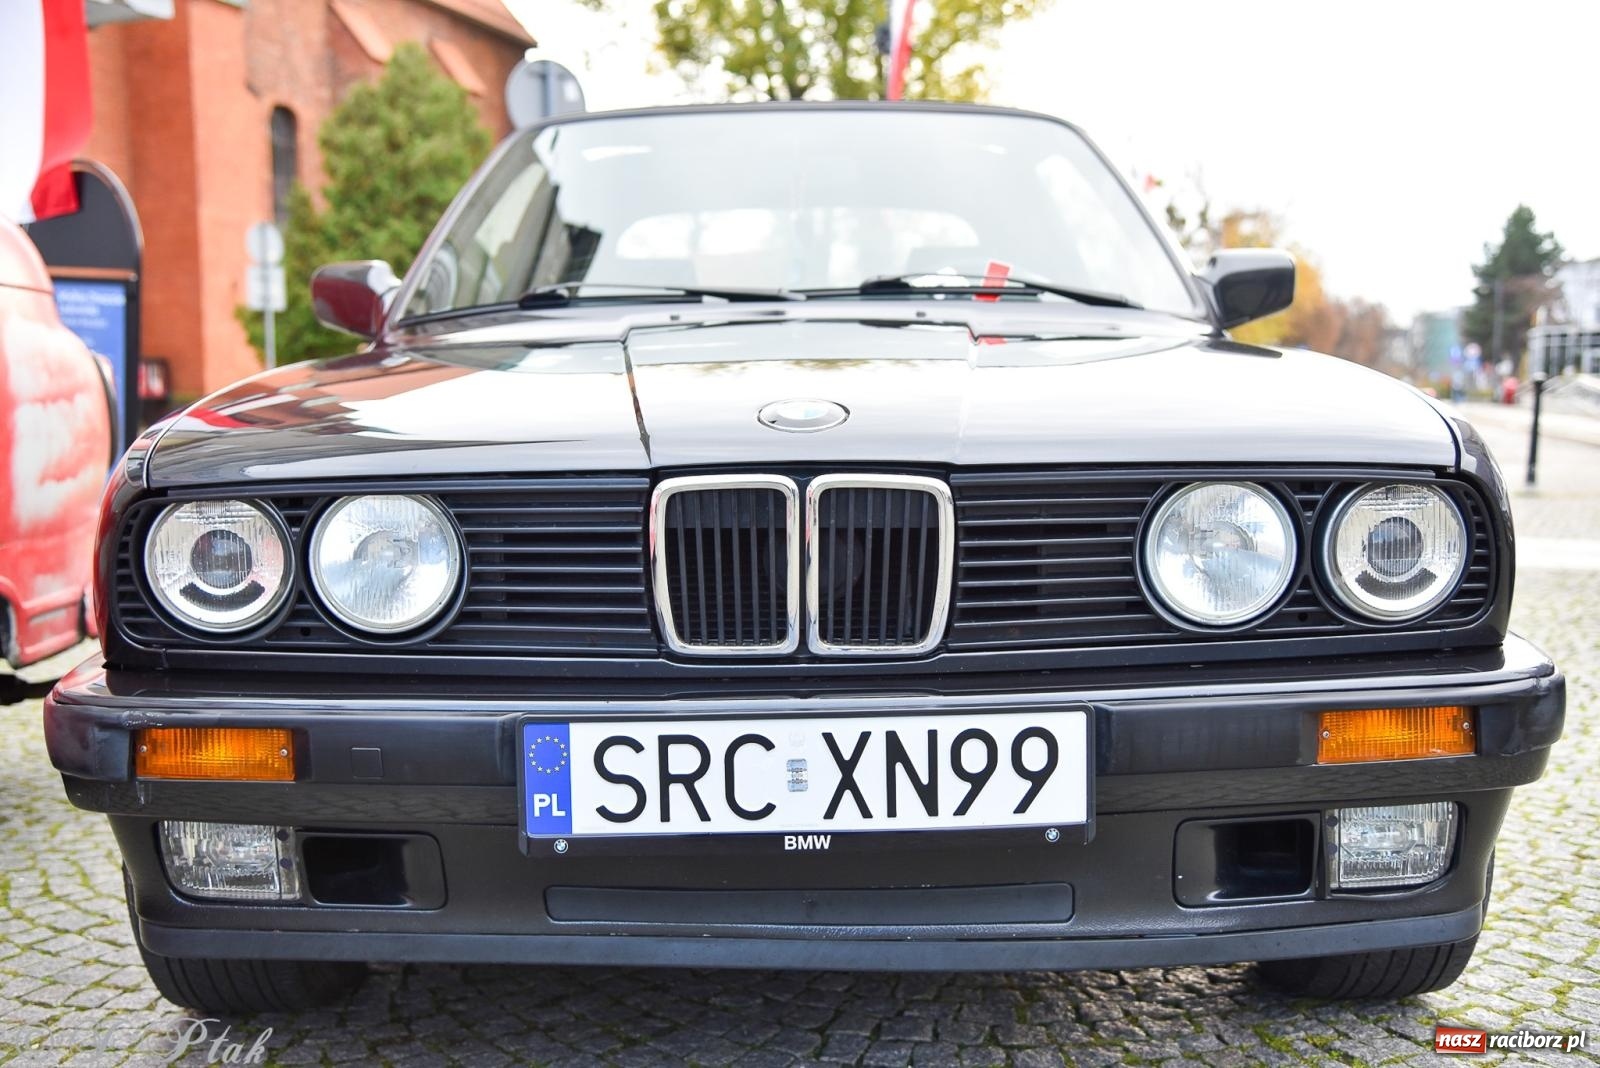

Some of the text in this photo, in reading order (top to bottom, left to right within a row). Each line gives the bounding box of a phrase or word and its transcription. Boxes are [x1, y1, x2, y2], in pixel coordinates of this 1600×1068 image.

[593, 726, 1059, 823] SRC XN99
[533, 793, 566, 817] PL
[784, 834, 831, 850] BMW
